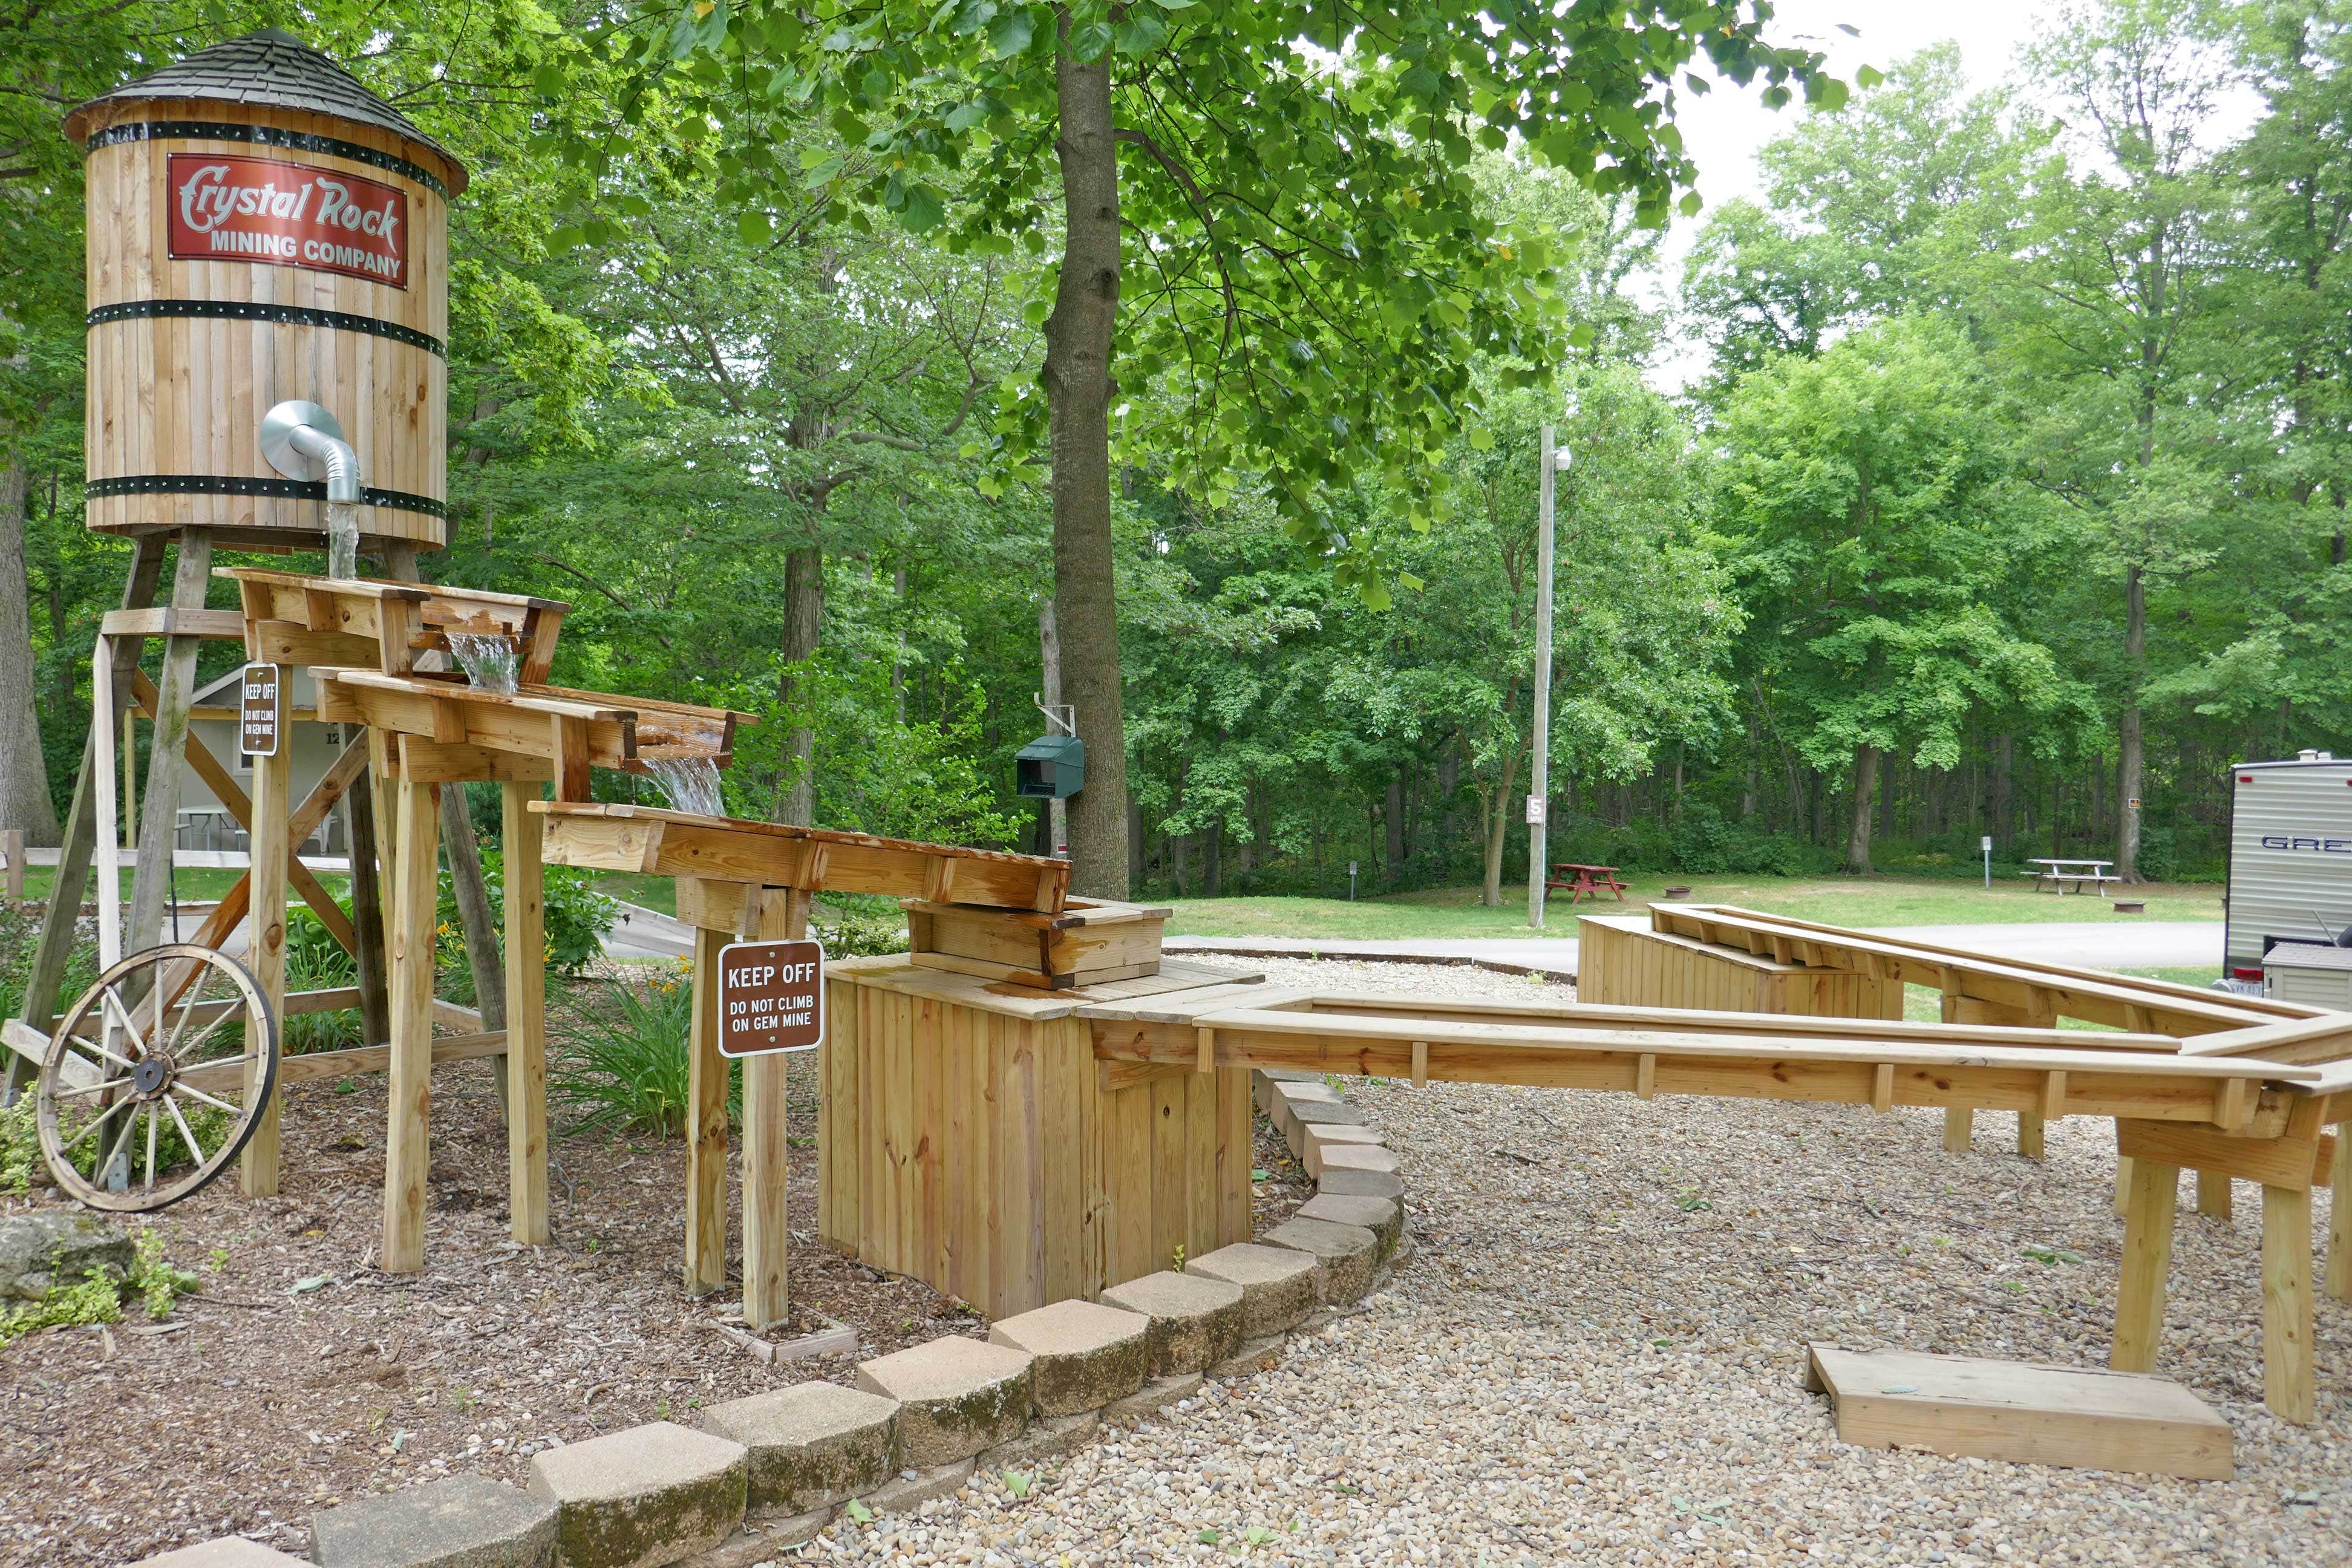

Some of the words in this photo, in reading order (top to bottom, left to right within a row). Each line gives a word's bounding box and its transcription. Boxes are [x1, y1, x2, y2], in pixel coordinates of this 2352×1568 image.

[179, 165, 313, 232] Crystal
[315, 177, 400, 256] Rock
[211, 230, 297, 257] MINING
[304, 240, 401, 278] COMPANY
[245, 684, 261, 700] KEEP
[263, 683, 275, 699] OFF
[245, 710, 252, 721] DO
[252, 710, 261, 721] NOT
[261, 710, 274, 721] CLIMB
[246, 724, 252, 734] ON
[1530, 799, 1541, 815] 5
[728, 966, 775, 988] KEEP
[782, 962, 815, 984] OFF
[730, 1001, 746, 1015] DO
[751, 998, 774, 1013] NOT
[778, 995, 814, 1011] CLIMB
[733, 1018, 749, 1033] ON
[754, 1015, 778, 1030] GEM
[783, 1011, 811, 1027] MINE
